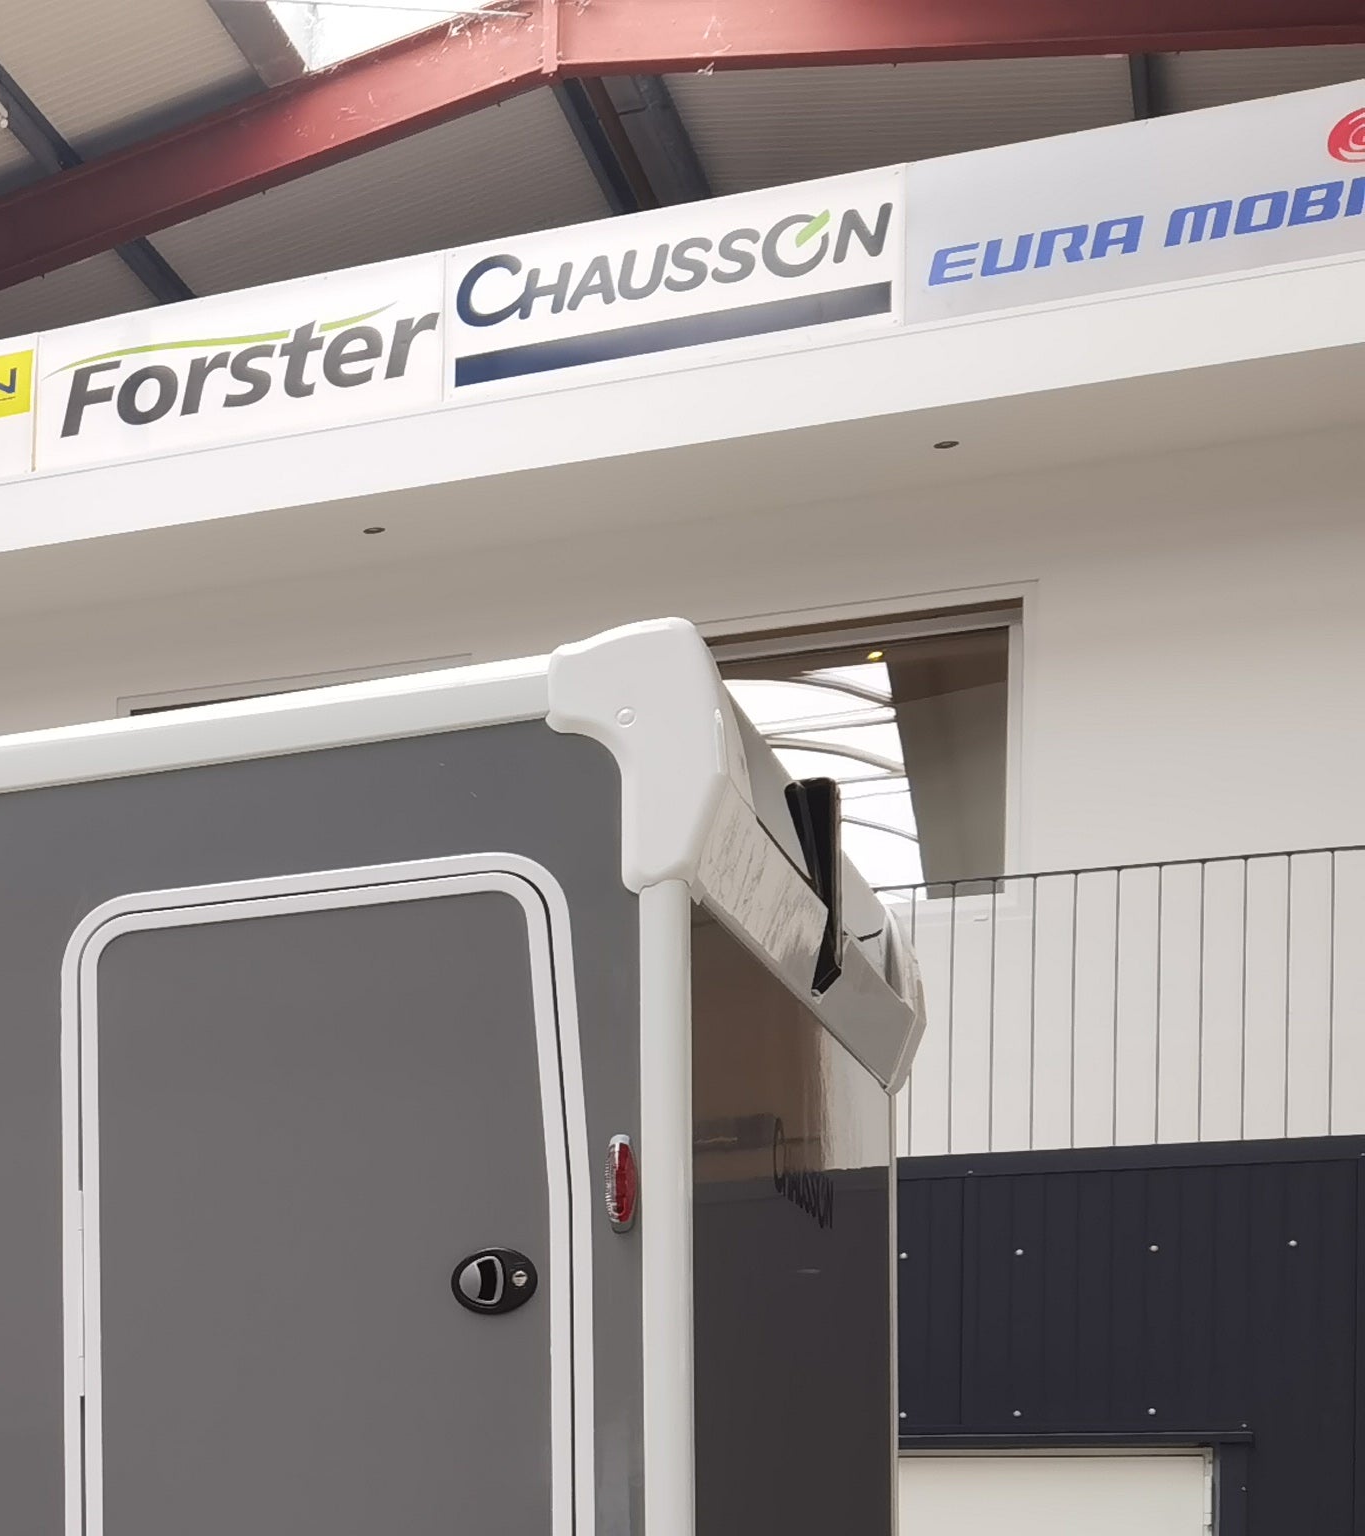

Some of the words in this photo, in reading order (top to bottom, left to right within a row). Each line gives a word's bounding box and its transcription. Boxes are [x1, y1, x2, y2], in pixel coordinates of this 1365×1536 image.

[456, 202, 893, 328] CHAUSSON
[927, 215, 1144, 287] EURA
[1164, 176, 1365, 247] MOBI
[60, 310, 441, 439] Forster
